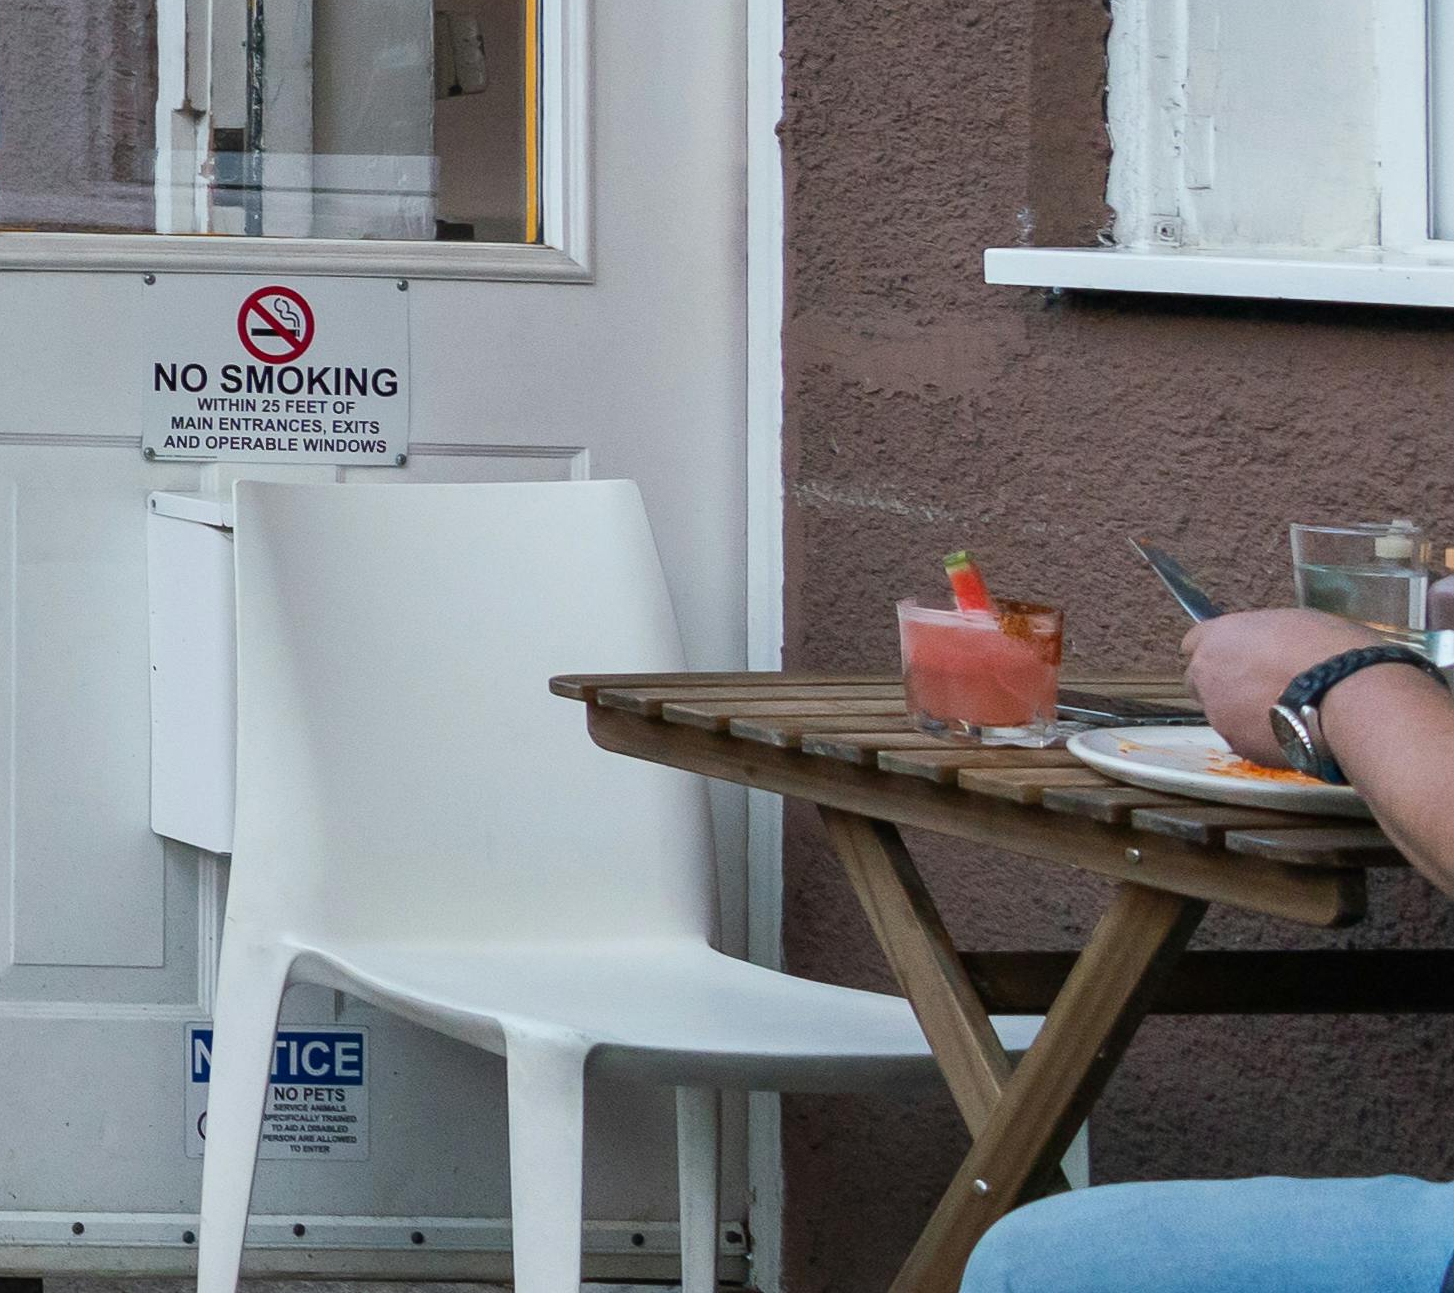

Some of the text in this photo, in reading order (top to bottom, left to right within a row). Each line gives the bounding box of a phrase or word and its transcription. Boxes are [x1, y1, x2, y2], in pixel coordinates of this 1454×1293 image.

[154, 363, 398, 397] NO SMOKING
[197, 398, 356, 414] WITHIN 25 FEET OF
[171, 416, 380, 435] MAIN ENTRANCES, EXITS
[164, 436, 387, 453] AND OPERABLE WINDOWS
[194, 1038, 361, 1077] NTICE
[274, 1087, 346, 1102] NO PETS
[273, 1103, 346, 1113] SERVICE ANIMALS
[263, 1114, 357, 1123] SPECIFICALLY TRAINED
[272, 1124, 284, 1132] TO
[285, 1124, 298, 1132] AID
[308, 1125, 349, 1133] DISABLED
[262, 1134, 357, 1144] PERSON ARE ALLOWED
[290, 1145, 330, 1153] TO ENTER
